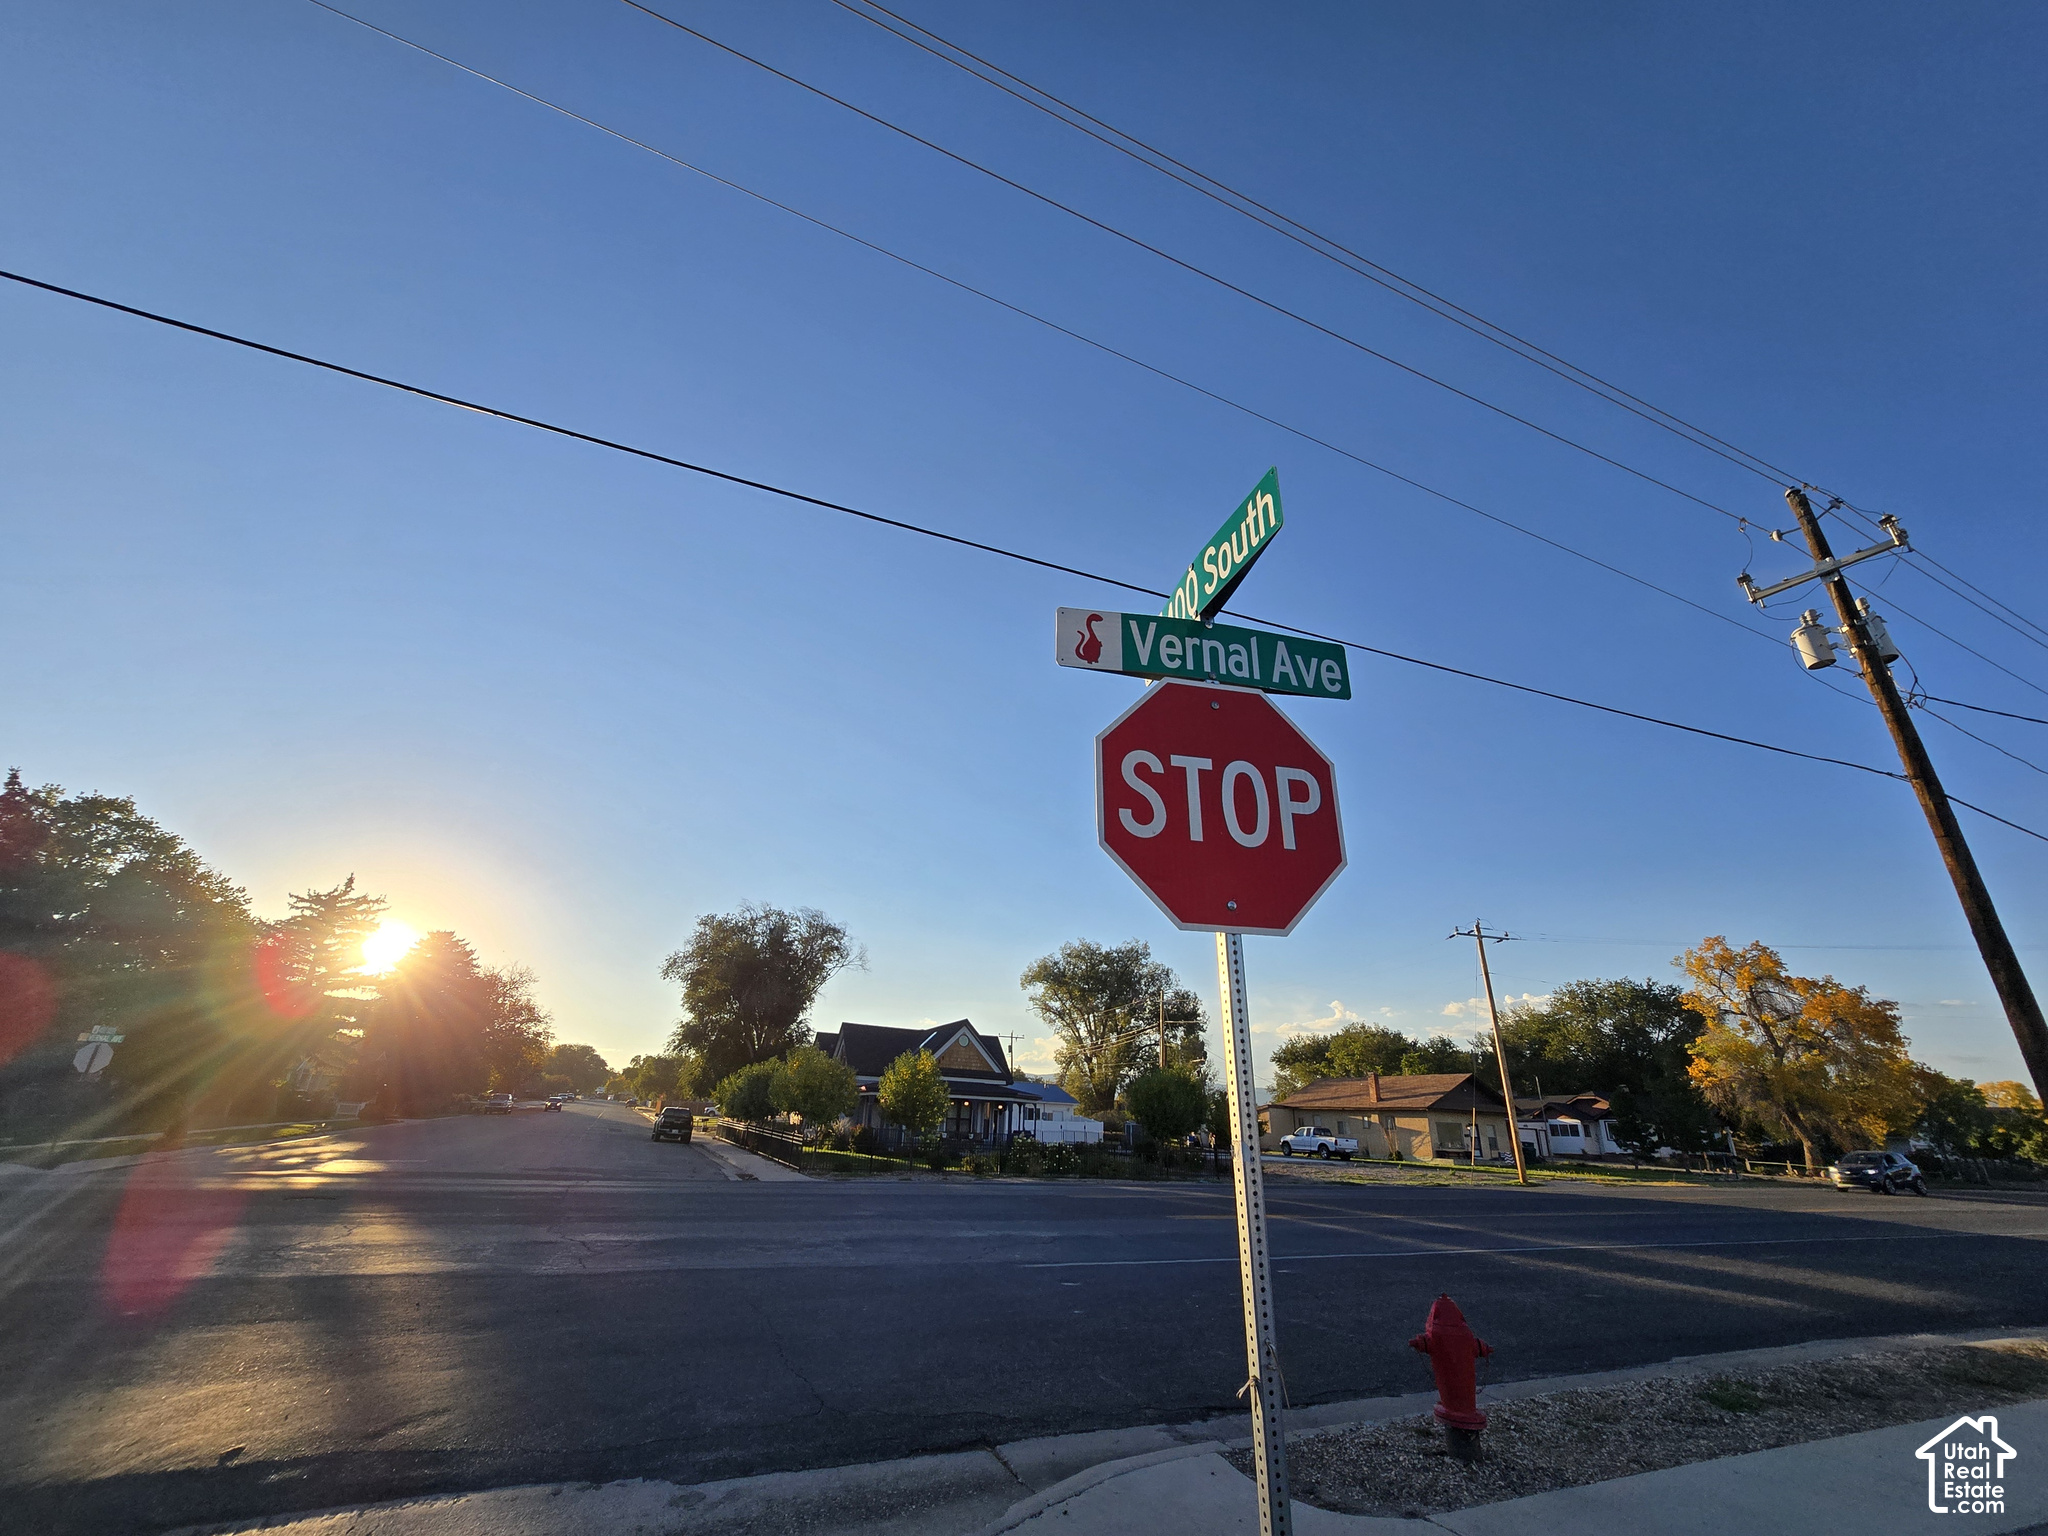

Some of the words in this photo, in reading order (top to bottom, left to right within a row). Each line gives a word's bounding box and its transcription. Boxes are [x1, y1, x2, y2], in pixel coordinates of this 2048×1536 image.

[1203, 489, 1276, 595] South
[1129, 620, 1260, 680] Vernal
[1272, 641, 1342, 692] Ave
[1118, 749, 1321, 850] STOP
